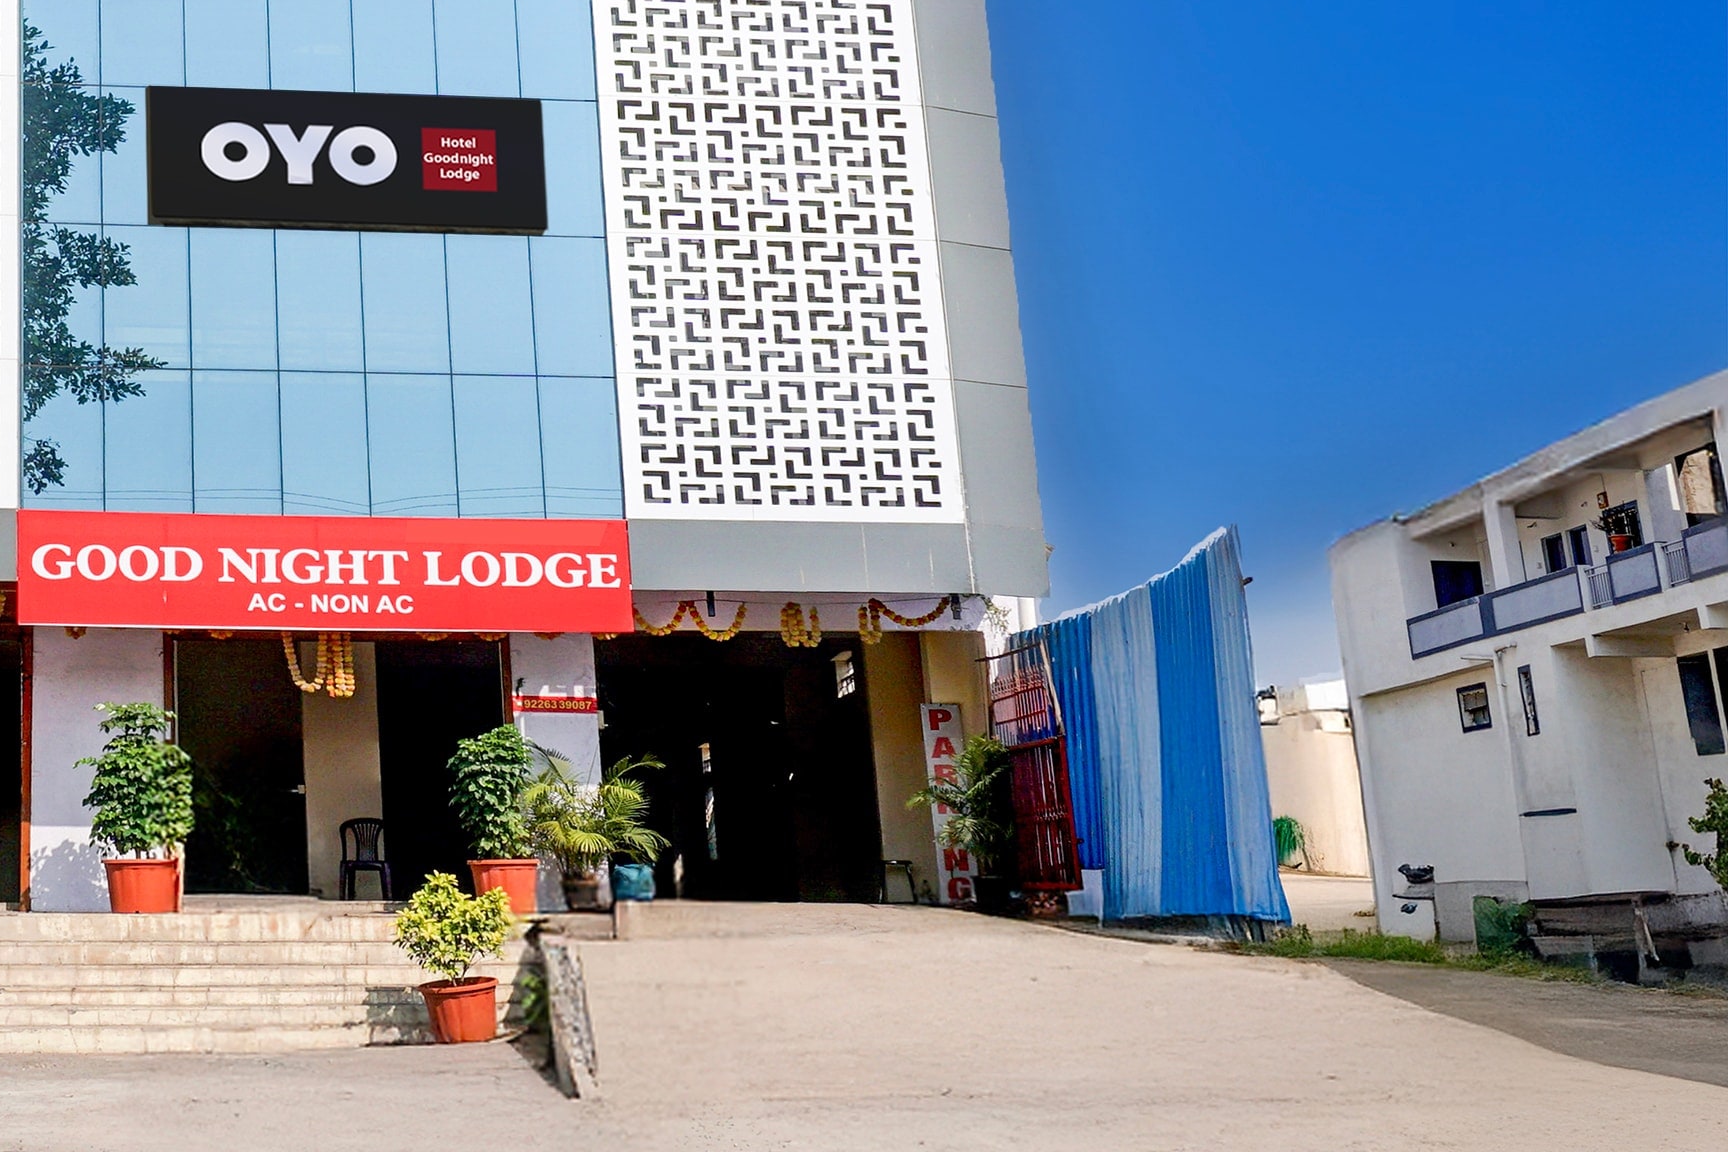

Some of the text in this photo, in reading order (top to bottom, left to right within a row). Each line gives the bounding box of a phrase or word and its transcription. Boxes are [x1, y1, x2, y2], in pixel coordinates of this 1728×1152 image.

[201, 121, 398, 186] OYO
[440, 137, 477, 149] Hotel
[423, 152, 494, 167] Goodnight
[439, 168, 481, 182] Lodge
[32, 543, 622, 589] GOOD NIGHT LODGE
[247, 592, 286, 612] AC
[311, 593, 373, 614] NON
[376, 594, 414, 615] AC
[928, 708, 971, 903] PARNG
